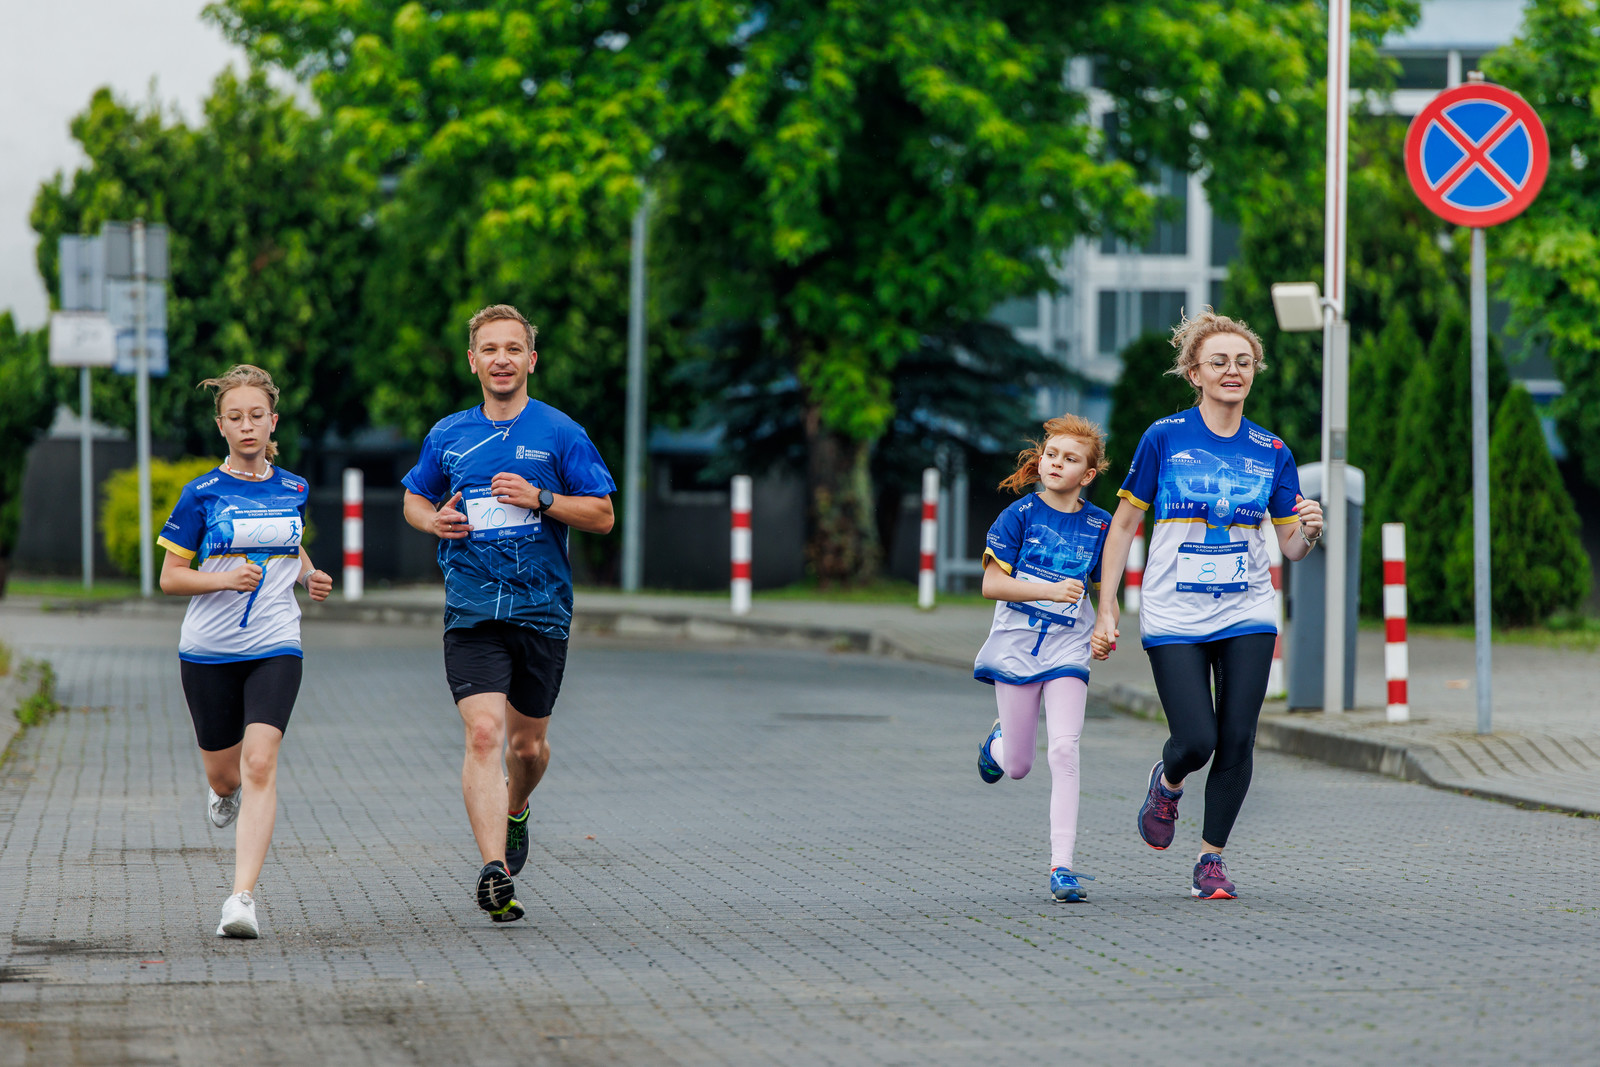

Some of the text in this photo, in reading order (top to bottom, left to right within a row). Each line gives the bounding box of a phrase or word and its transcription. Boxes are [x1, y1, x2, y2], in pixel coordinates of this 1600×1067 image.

[1249, 430, 1271, 442] CENTRUM
[1164, 502, 1194, 510] BIEGAM
[481, 507, 507, 527] 10
[247, 524, 279, 544] 10
[1197, 562, 1217, 583] 8
